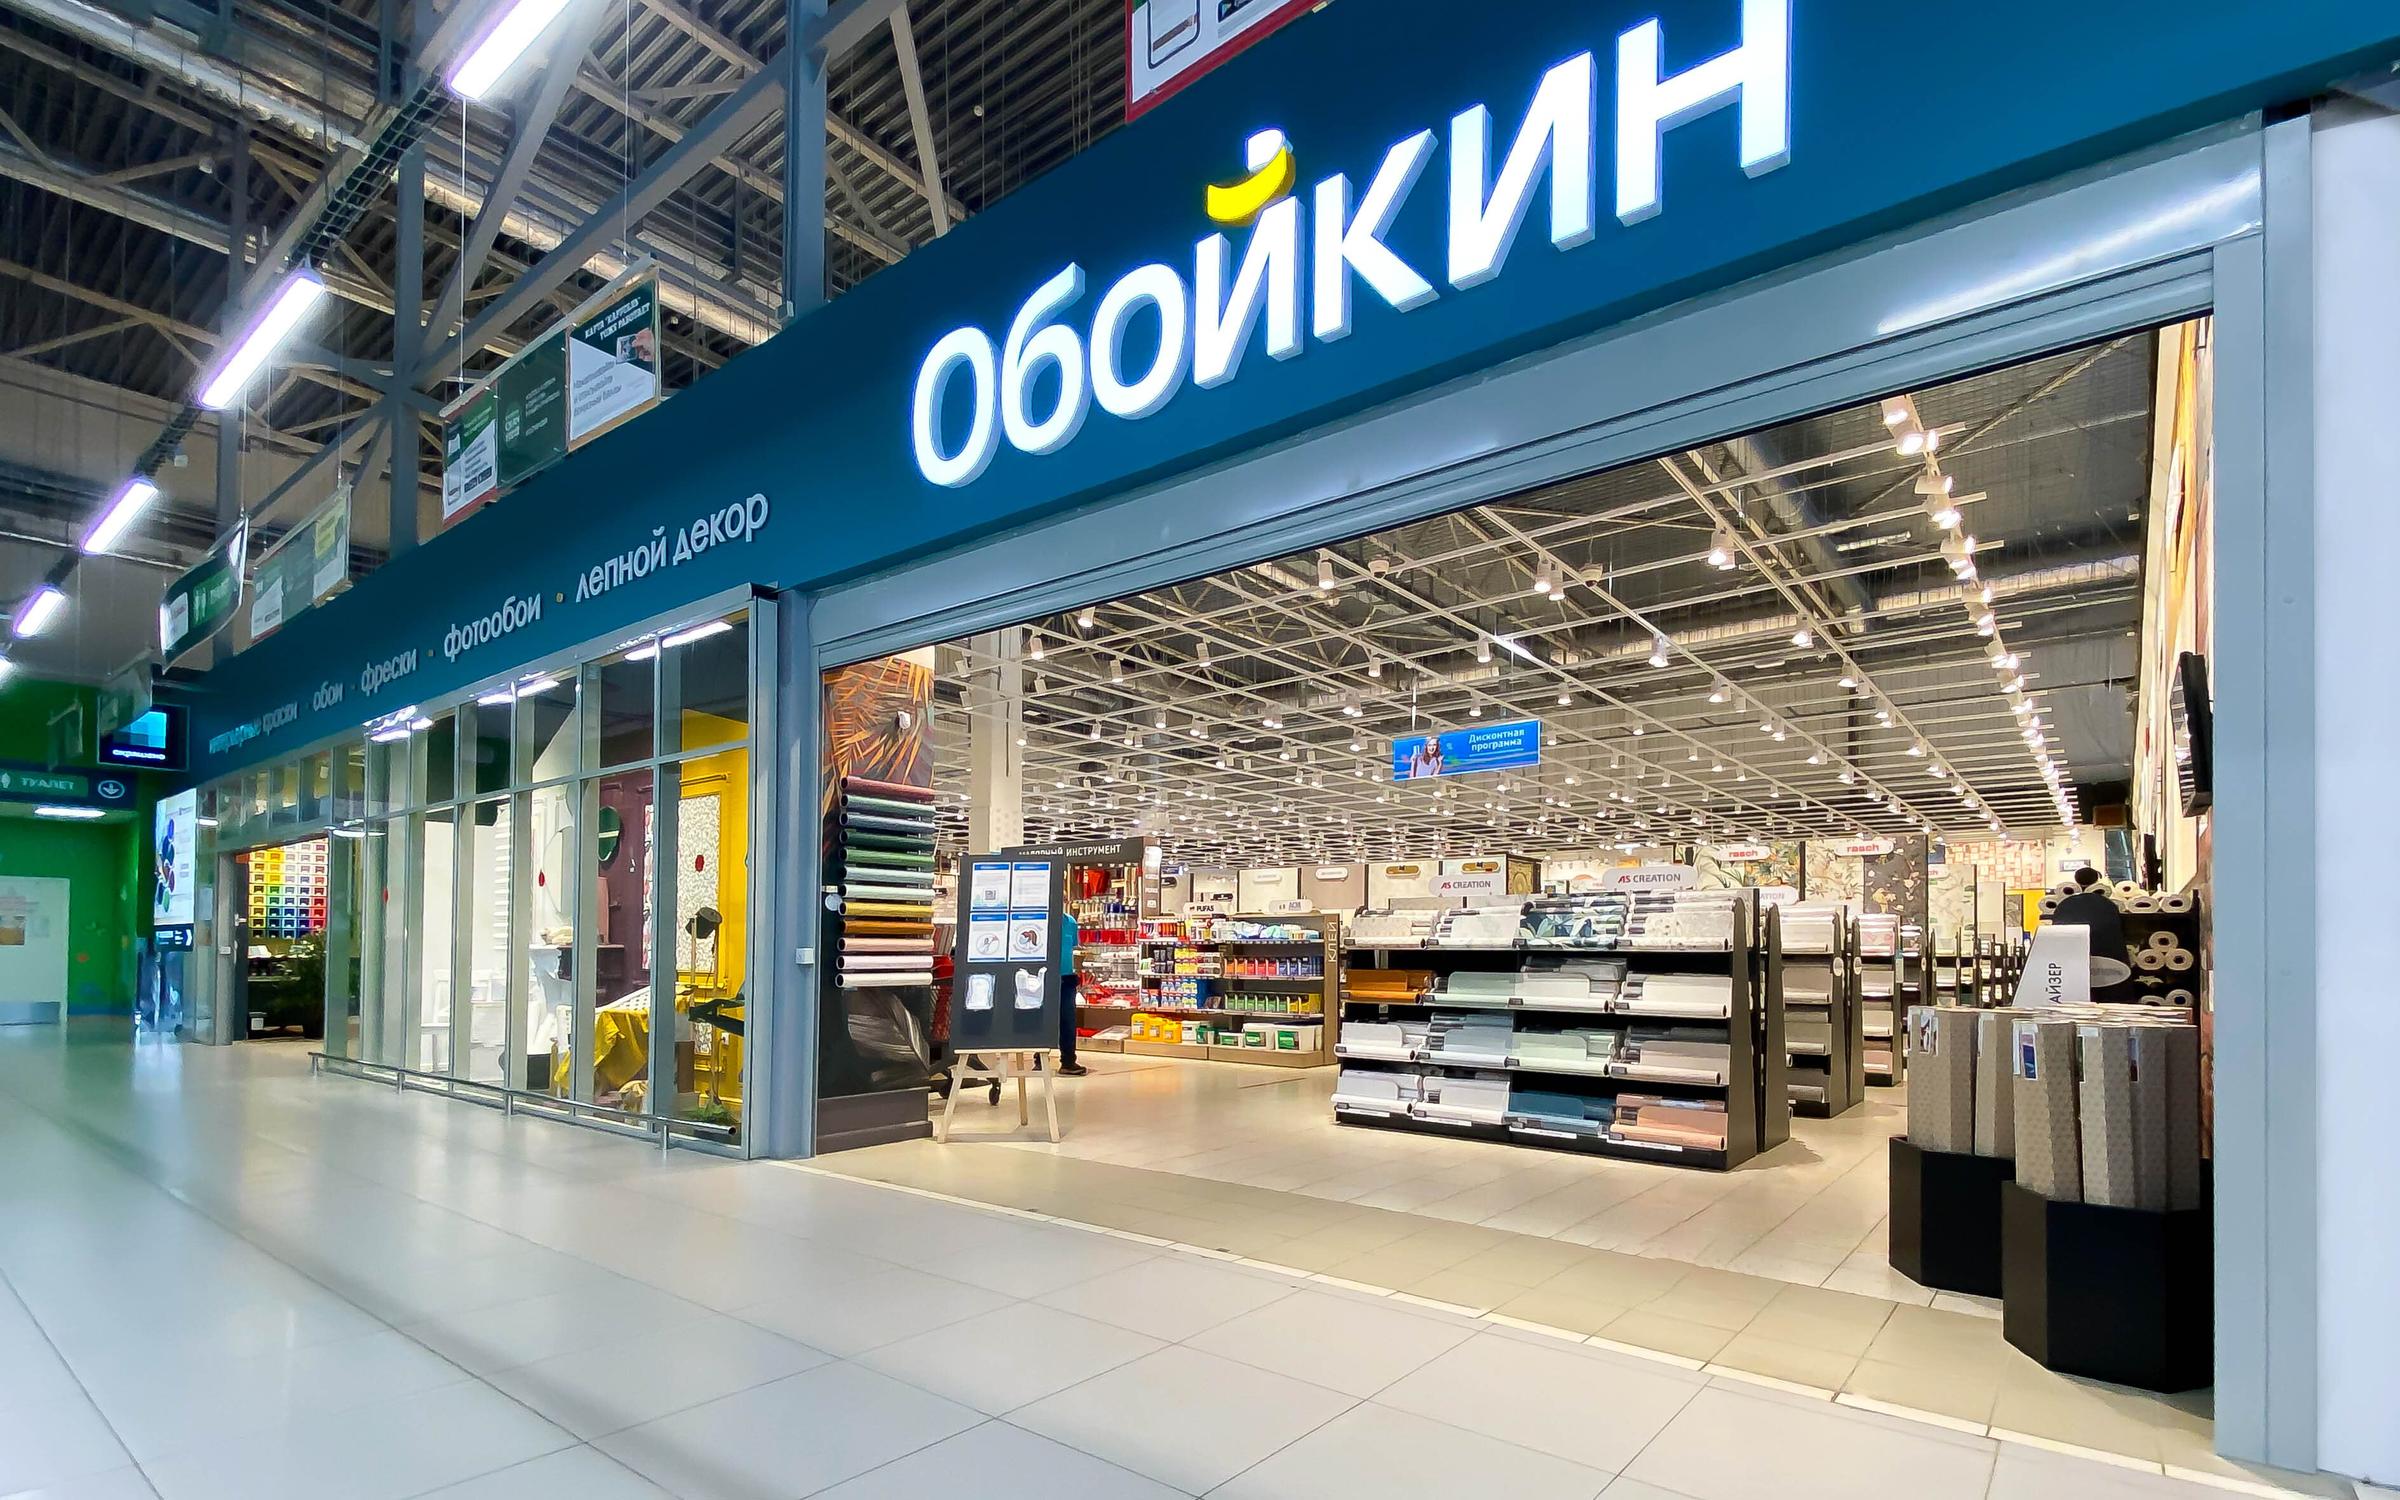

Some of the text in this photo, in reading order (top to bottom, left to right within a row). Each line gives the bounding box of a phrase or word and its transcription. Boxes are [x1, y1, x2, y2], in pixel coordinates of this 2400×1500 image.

[313, 681, 344, 711] обои
[361, 648, 417, 696] фрески
[444, 593, 541, 662] фотообои
[575, 525, 667, 603] лепной
[672, 493, 769, 566] декор
[1468, 728, 1525, 744] Дисконтная
[1471, 738, 1523, 752] программа
[1065, 844, 1122, 857] ИНСТРУМЕНТ
[1452, 880, 1492, 889] CREATION
[1617, 872, 1681, 884] AS CREATION
[1327, 921, 1337, 962] КЛЕЙ
[2045, 962, 2063, 1005] АЙЗЕР
